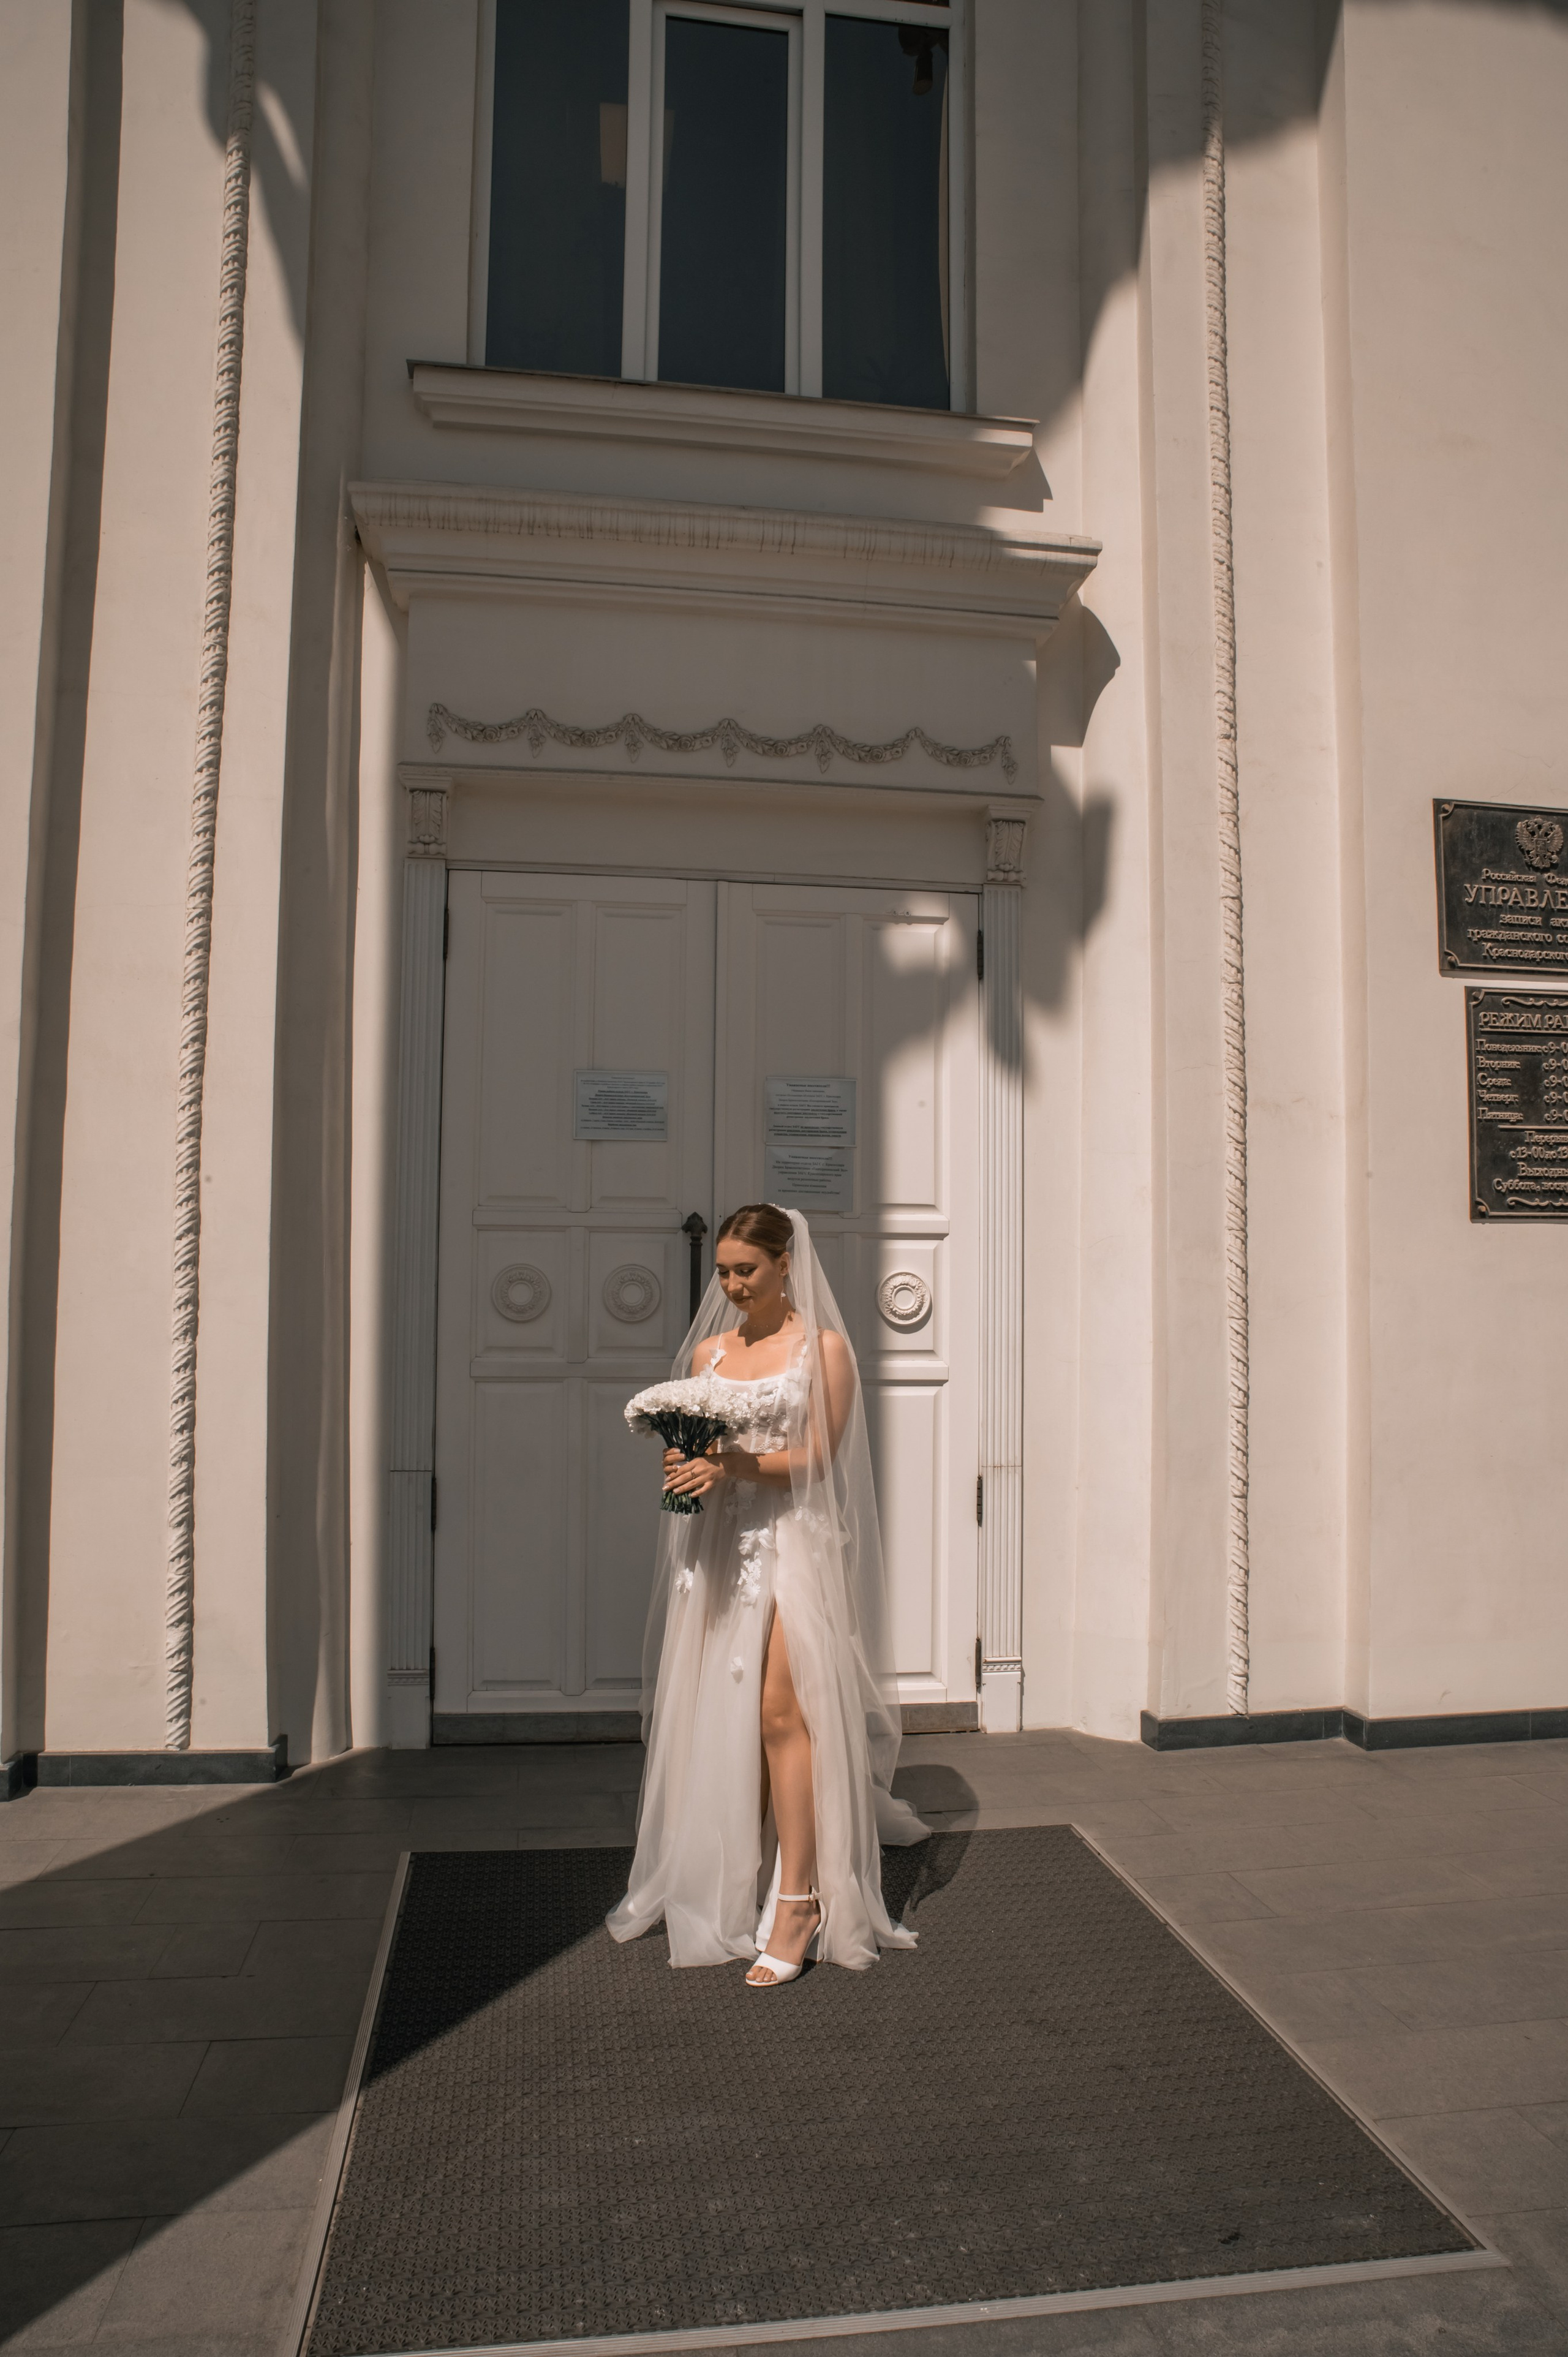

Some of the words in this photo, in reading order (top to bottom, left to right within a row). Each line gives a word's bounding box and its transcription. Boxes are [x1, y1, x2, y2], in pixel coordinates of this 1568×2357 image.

[1481, 868, 1536, 883] Российская
[1464, 884, 1568, 910] УПРАВЛЕ
[1499, 914, 1542, 926] записи
[1467, 929, 1552, 942] гражданского
[1479, 1011, 1542, 1028] РЕЖИМ
[1492, 1178, 1540, 1193] Суббота,
